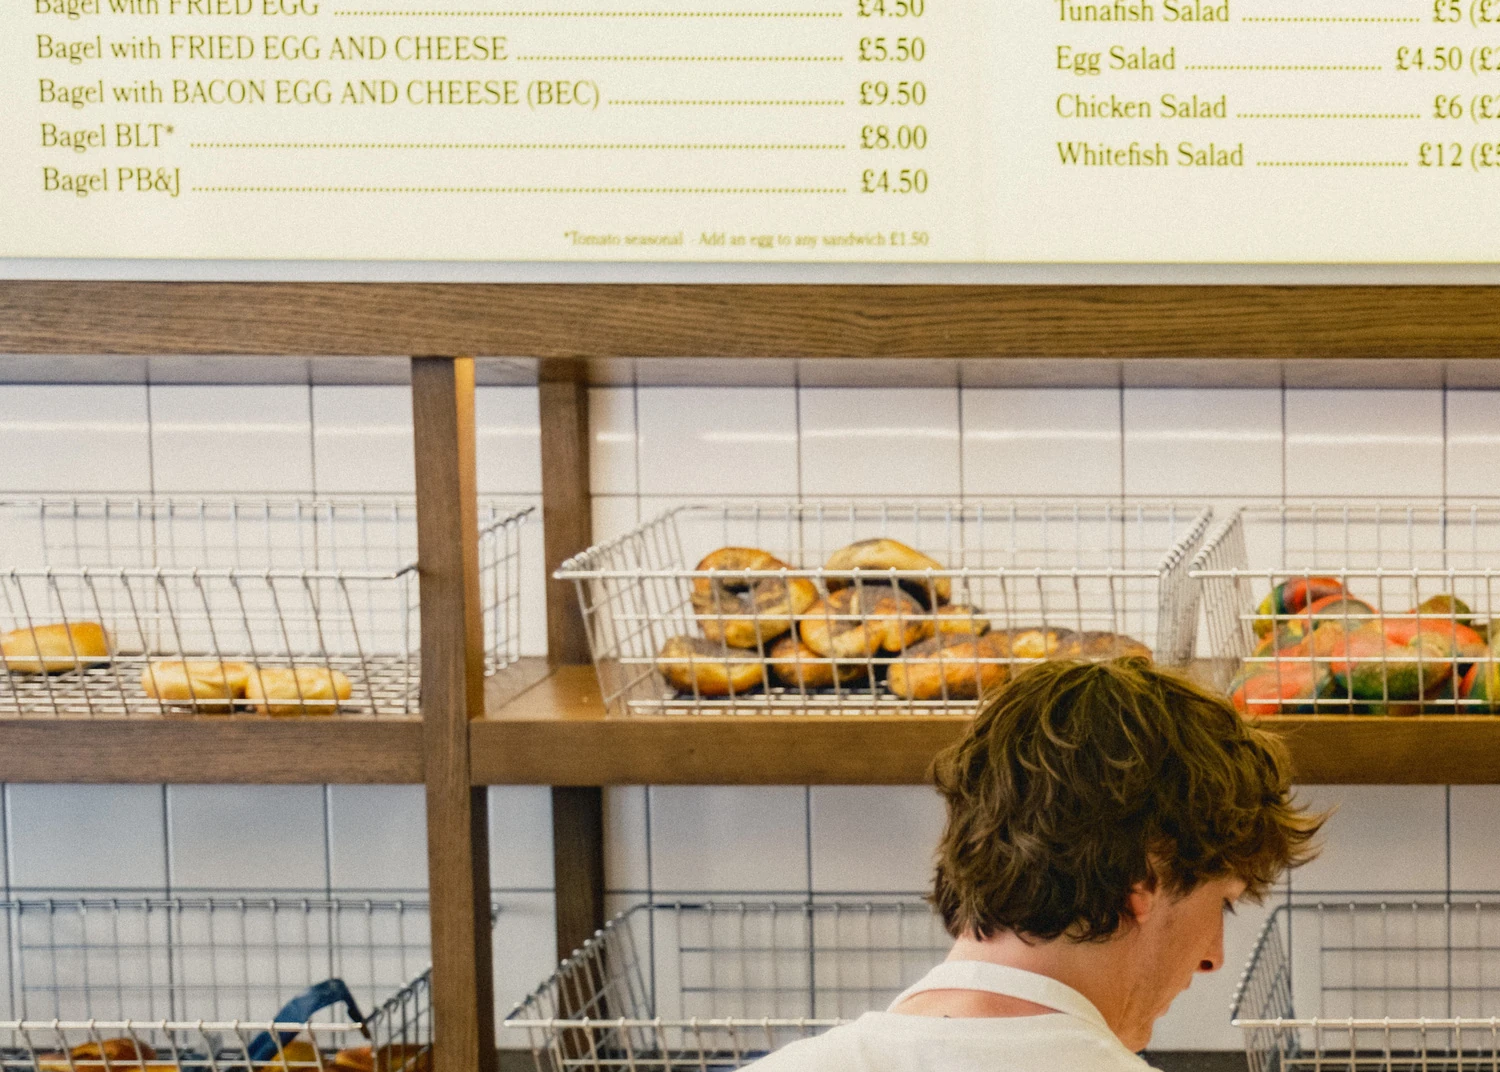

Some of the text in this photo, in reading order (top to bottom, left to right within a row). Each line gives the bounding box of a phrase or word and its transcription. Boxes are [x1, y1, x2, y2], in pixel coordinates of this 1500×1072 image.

[35, 0, 100, 20] Bagel
[262, 0, 319, 16] EGG
[857, 0, 925, 18] £4.50
[1054, 0, 1154, 22] Tunafish
[1162, 0, 1230, 22] Salad
[1432, 0, 1463, 23] £5
[36, 34, 926, 64] Bagel with FRIED EGG AND CHEESE £5.50
[1056, 45, 1101, 76] Egg
[1109, 45, 1176, 70] Salad
[1395, 46, 1463, 71] £4.50
[38, 78, 927, 110] Bagel with BACON EGG AND CHEESE (BEC) £9.50
[1055, 93, 1152, 118] Chicken
[1160, 93, 1227, 119] Salad
[1433, 94, 1463, 120] £6
[40, 122, 106, 153] Bagel
[860, 124, 928, 150] £8.00
[1056, 141, 1169, 167] Whitefish
[1177, 141, 1244, 167] Salad
[1418, 142, 1463, 168] £12
[43, 166, 929, 198] Bagel PB&J £4.50
[700, 231, 725, 246] Add
[730, 235, 746, 246] an
[778, 233, 791, 246] to
[795, 235, 817, 249] any
[822, 231, 886, 247] sandwich
